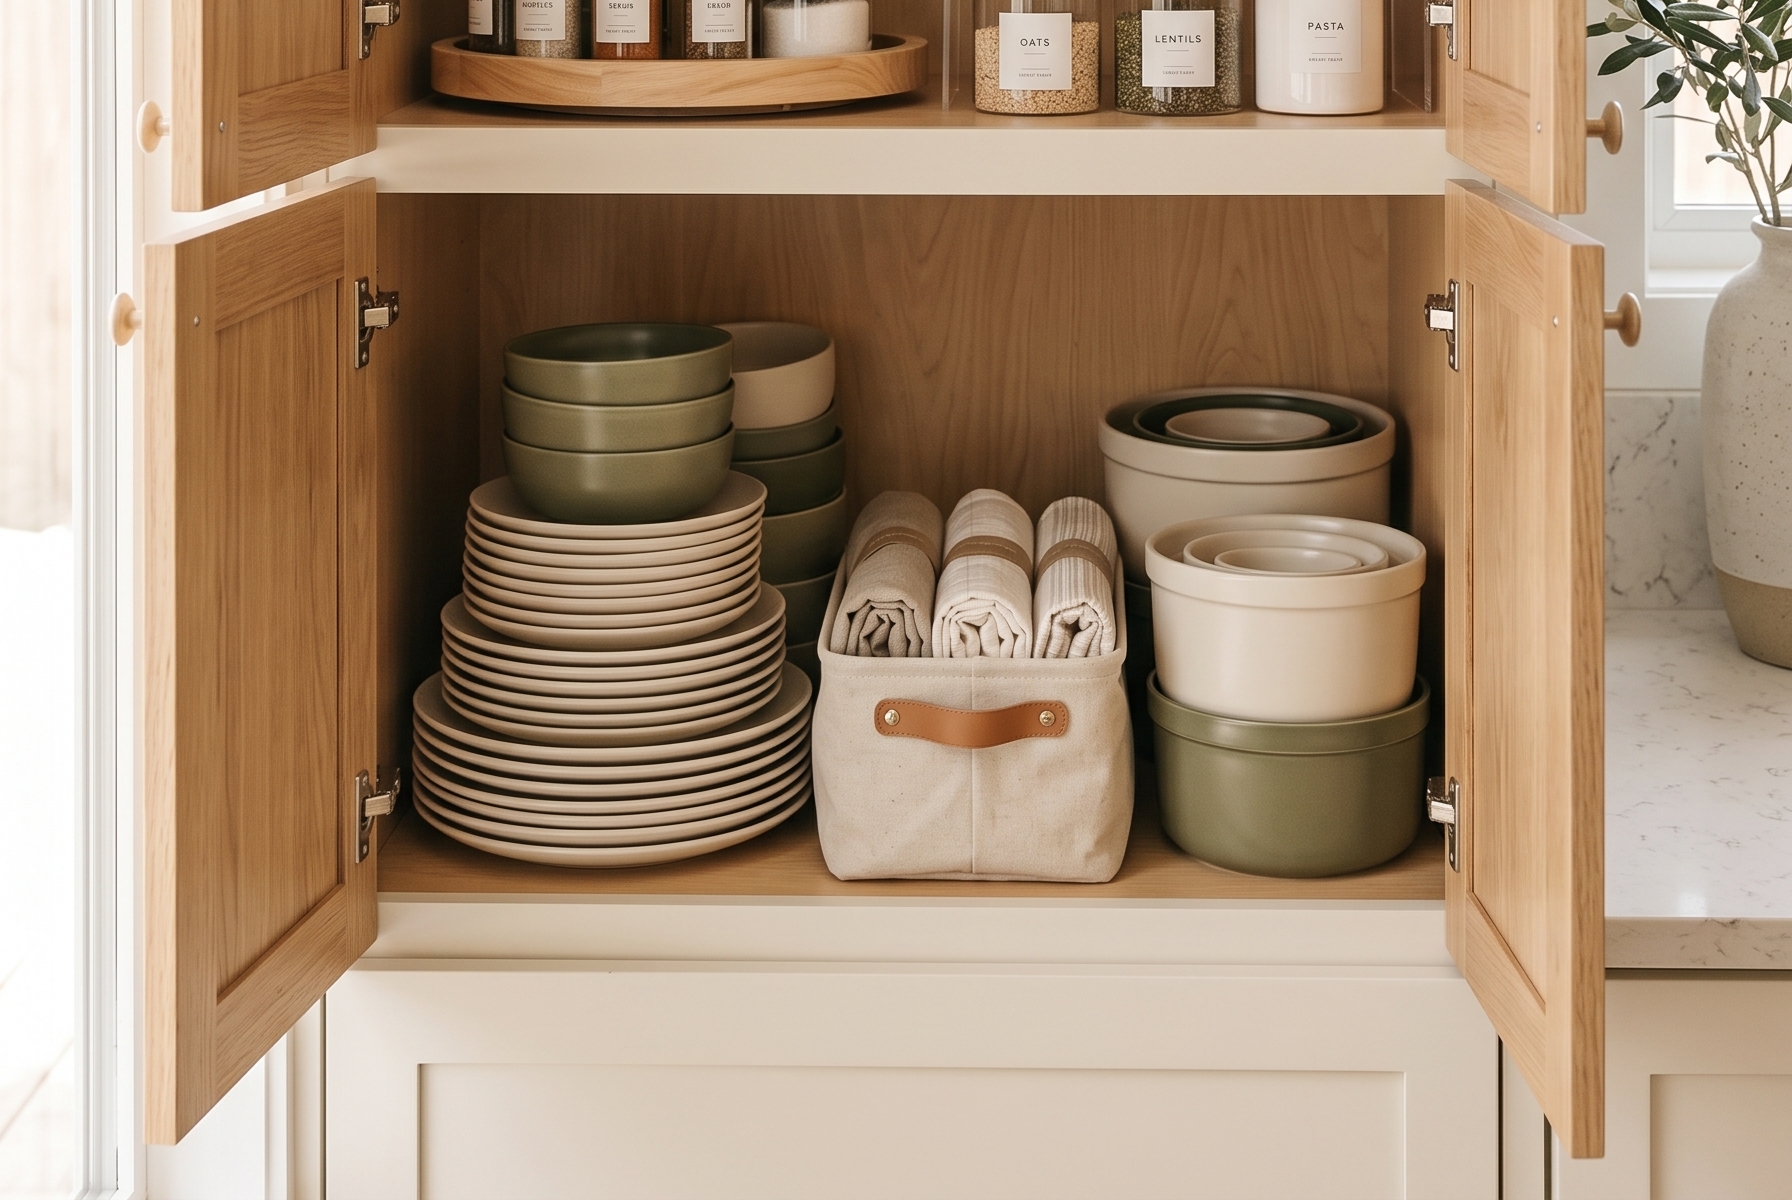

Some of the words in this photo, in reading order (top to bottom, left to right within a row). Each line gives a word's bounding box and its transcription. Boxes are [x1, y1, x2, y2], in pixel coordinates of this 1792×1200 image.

[1307, 22, 1345, 31] PASTA
[1019, 38, 1050, 47] OATS
[1155, 34, 1202, 44] LENTILS
